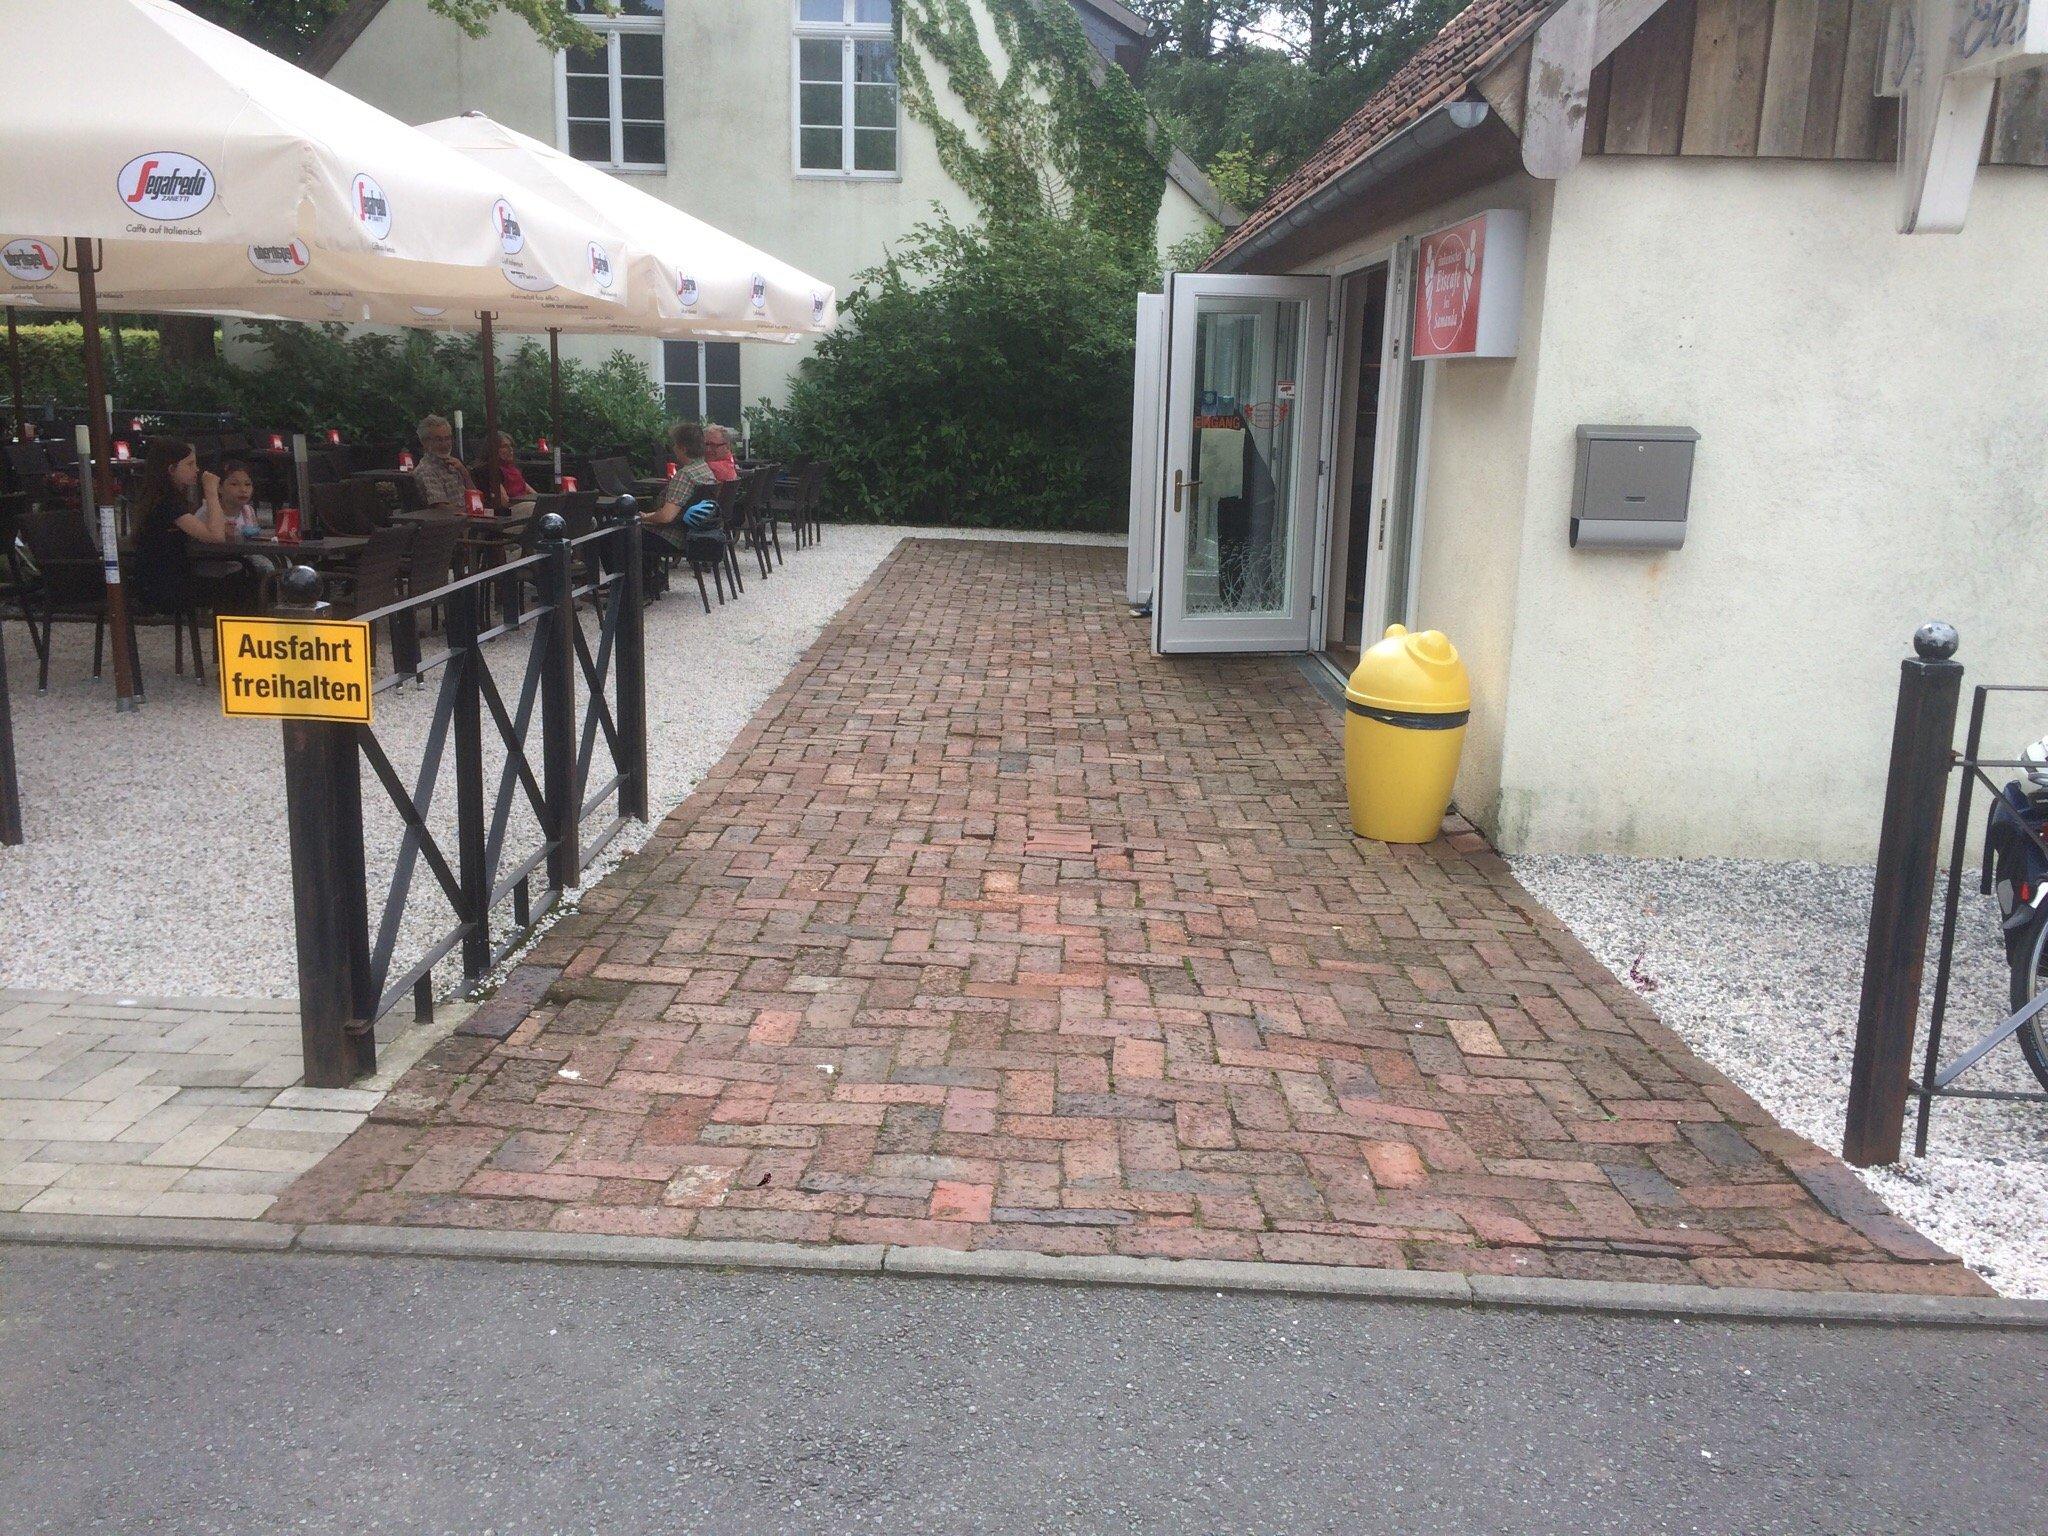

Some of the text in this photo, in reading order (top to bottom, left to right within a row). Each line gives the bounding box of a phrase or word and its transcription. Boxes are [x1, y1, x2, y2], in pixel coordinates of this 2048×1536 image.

[127, 160, 206, 203] Segafredo
[149, 225, 162, 235] auf
[163, 226, 202, 237] Italienisch
[238, 633, 353, 663] Ausfahrt
[232, 672, 362, 702] freihalten
